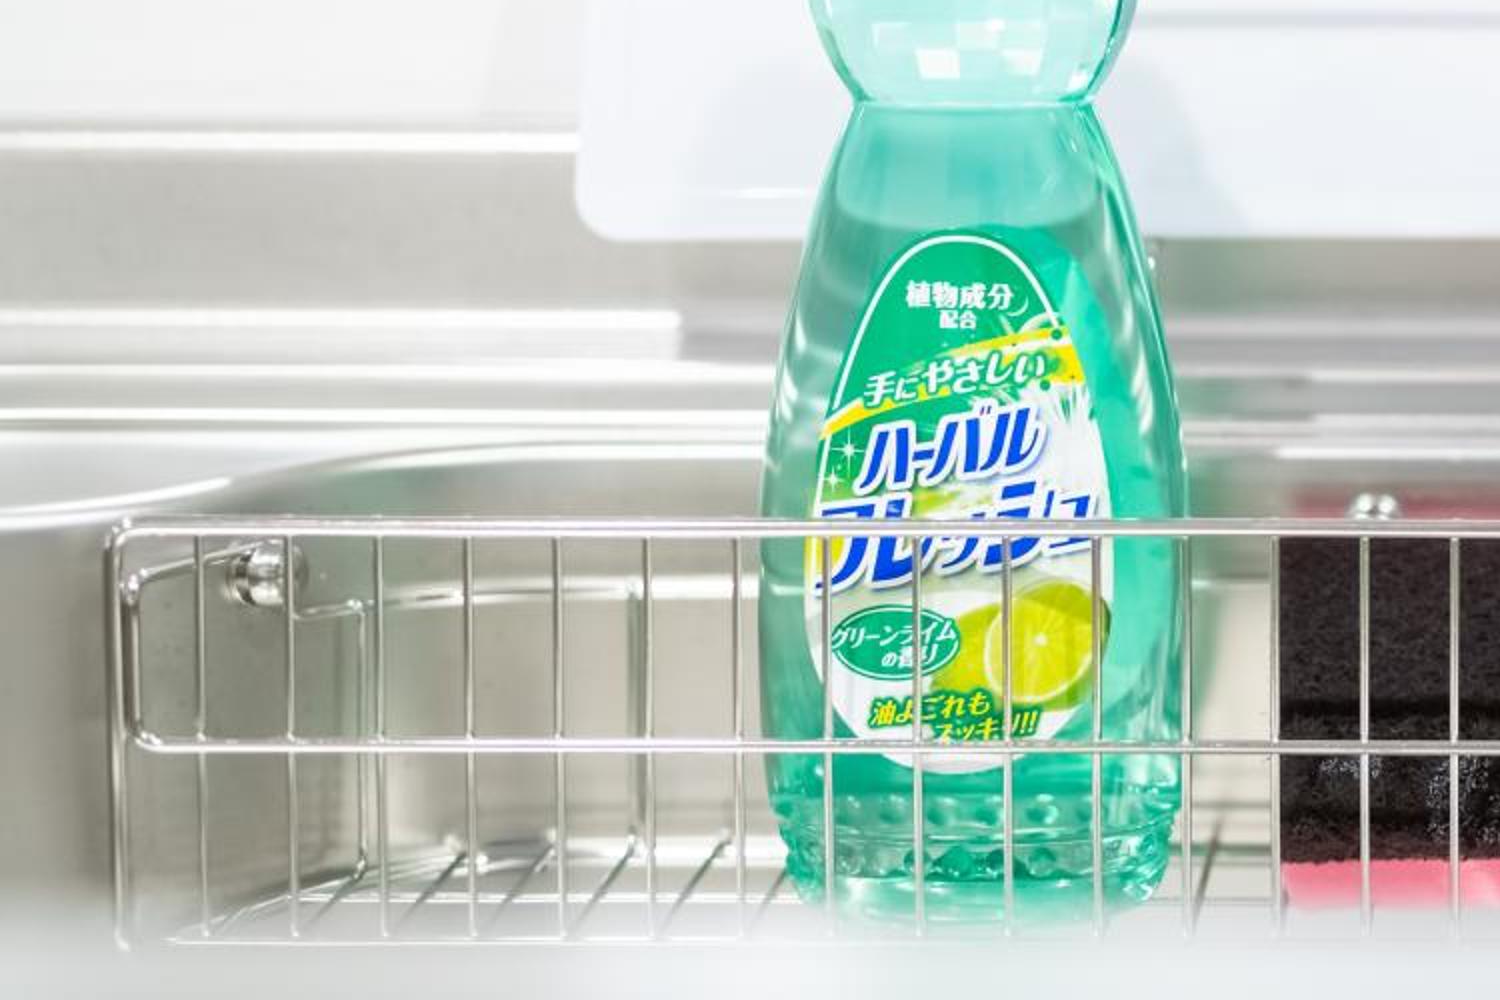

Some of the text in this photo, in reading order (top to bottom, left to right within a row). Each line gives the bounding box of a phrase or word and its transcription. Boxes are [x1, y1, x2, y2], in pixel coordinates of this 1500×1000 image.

[906, 280, 1014, 310] 植物成分
[939, 311, 977, 328] 配合
[864, 353, 1045, 406] 手にやさしい
[858, 406, 1039, 488] ハーバル
[832, 621, 956, 649] グリーンライム
